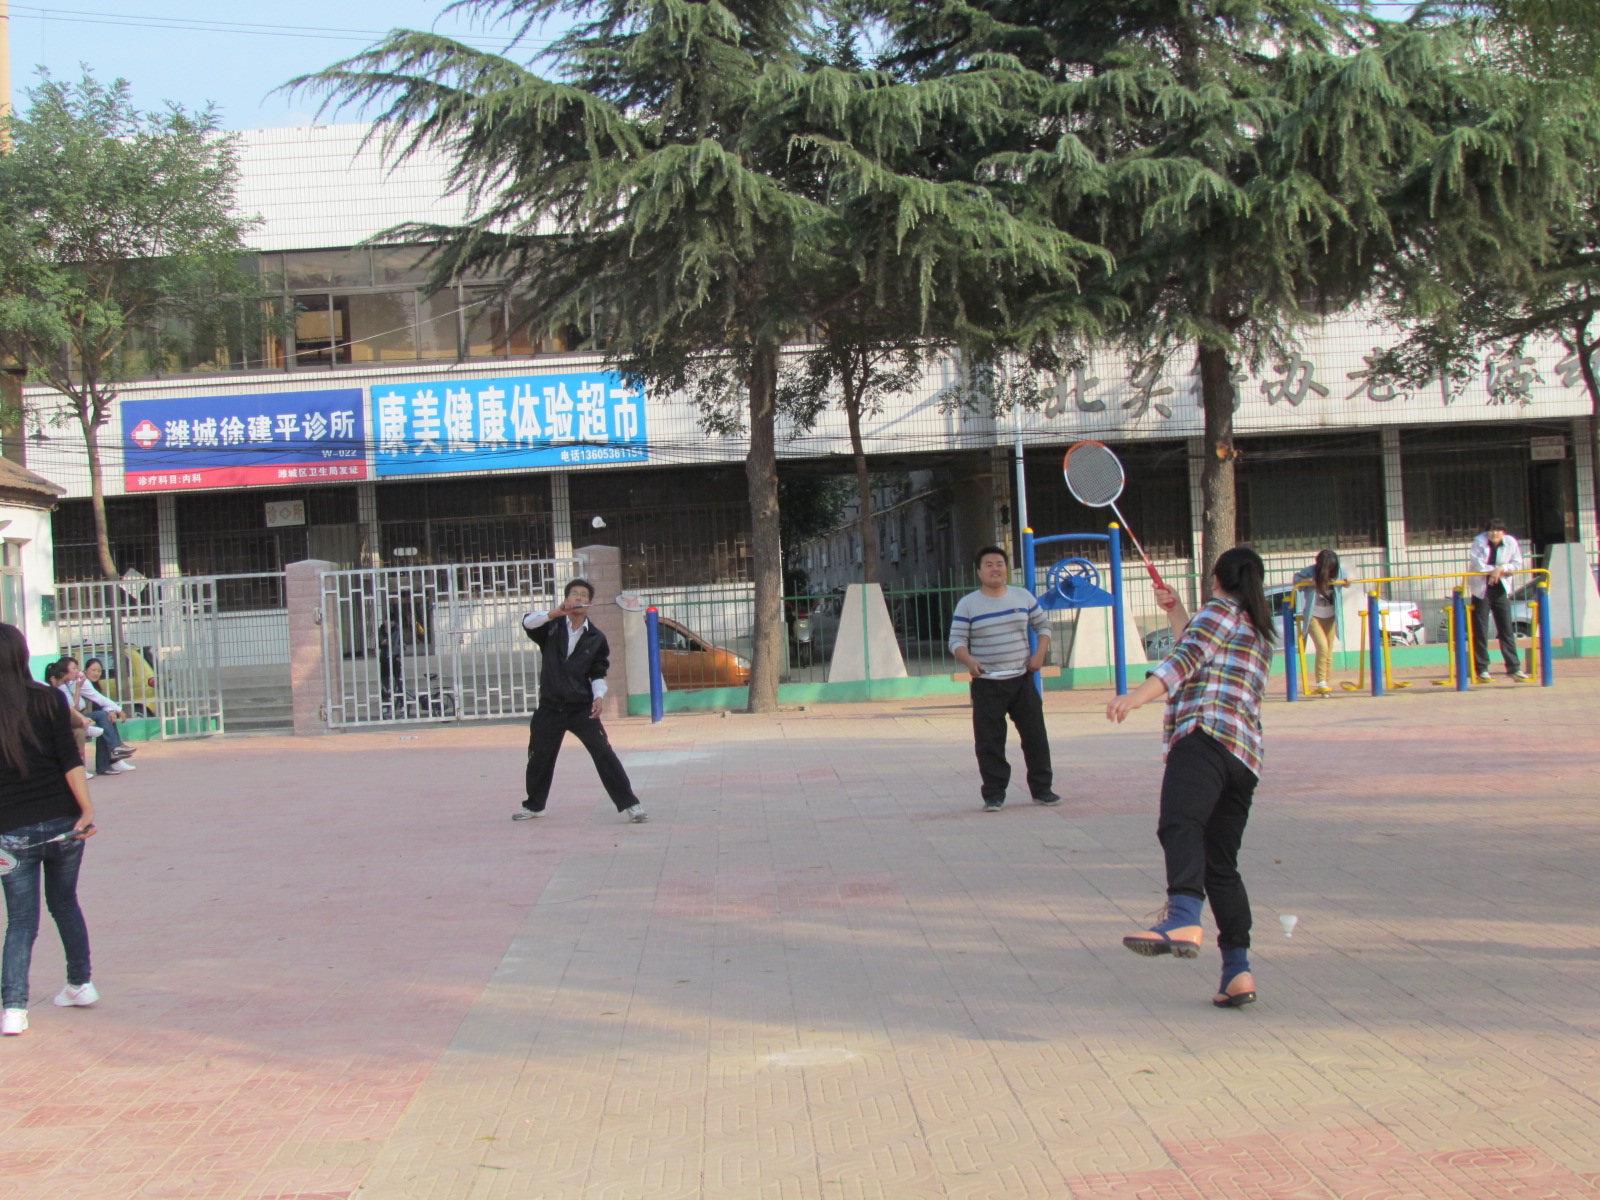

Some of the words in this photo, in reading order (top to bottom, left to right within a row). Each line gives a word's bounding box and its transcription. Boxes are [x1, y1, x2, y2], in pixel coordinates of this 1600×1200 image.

[164, 411, 356, 449] 潍城徐建平诊所
[378, 380, 639, 457] 康美健康体验超市
[277, 466, 359, 479] 潍城区卫生局发证
